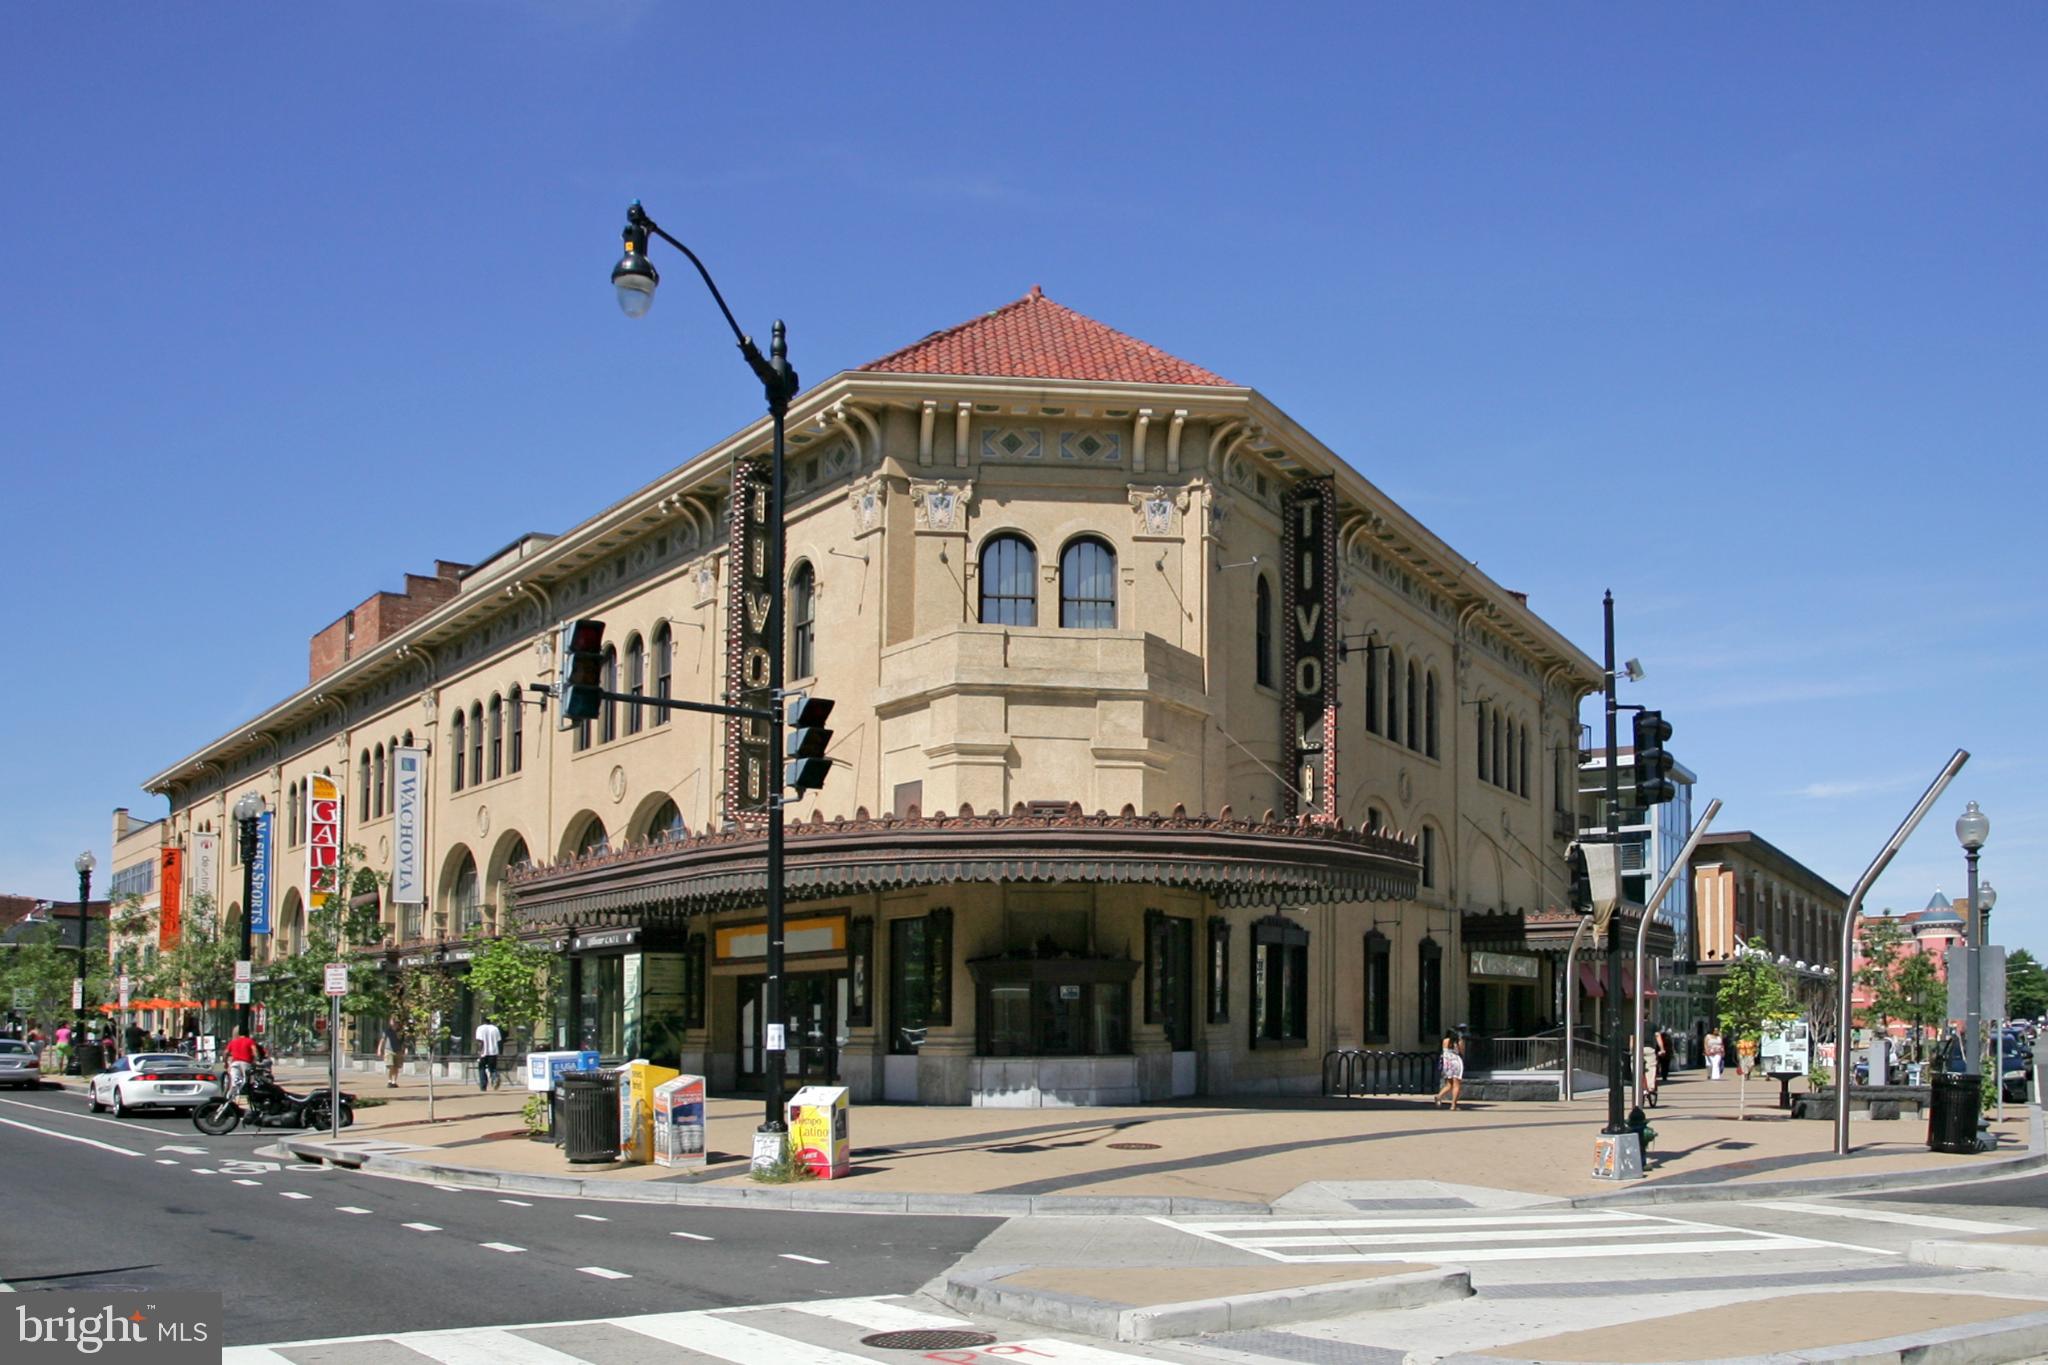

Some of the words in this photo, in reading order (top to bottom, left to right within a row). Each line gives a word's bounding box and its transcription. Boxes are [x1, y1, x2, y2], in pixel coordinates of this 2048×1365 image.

[742, 481, 771, 799] TIVOLI
[1296, 499, 1322, 803] TIVOLI
[250, 871, 265, 925] SPORTS
[400, 776, 416, 891] WACHOVIA
